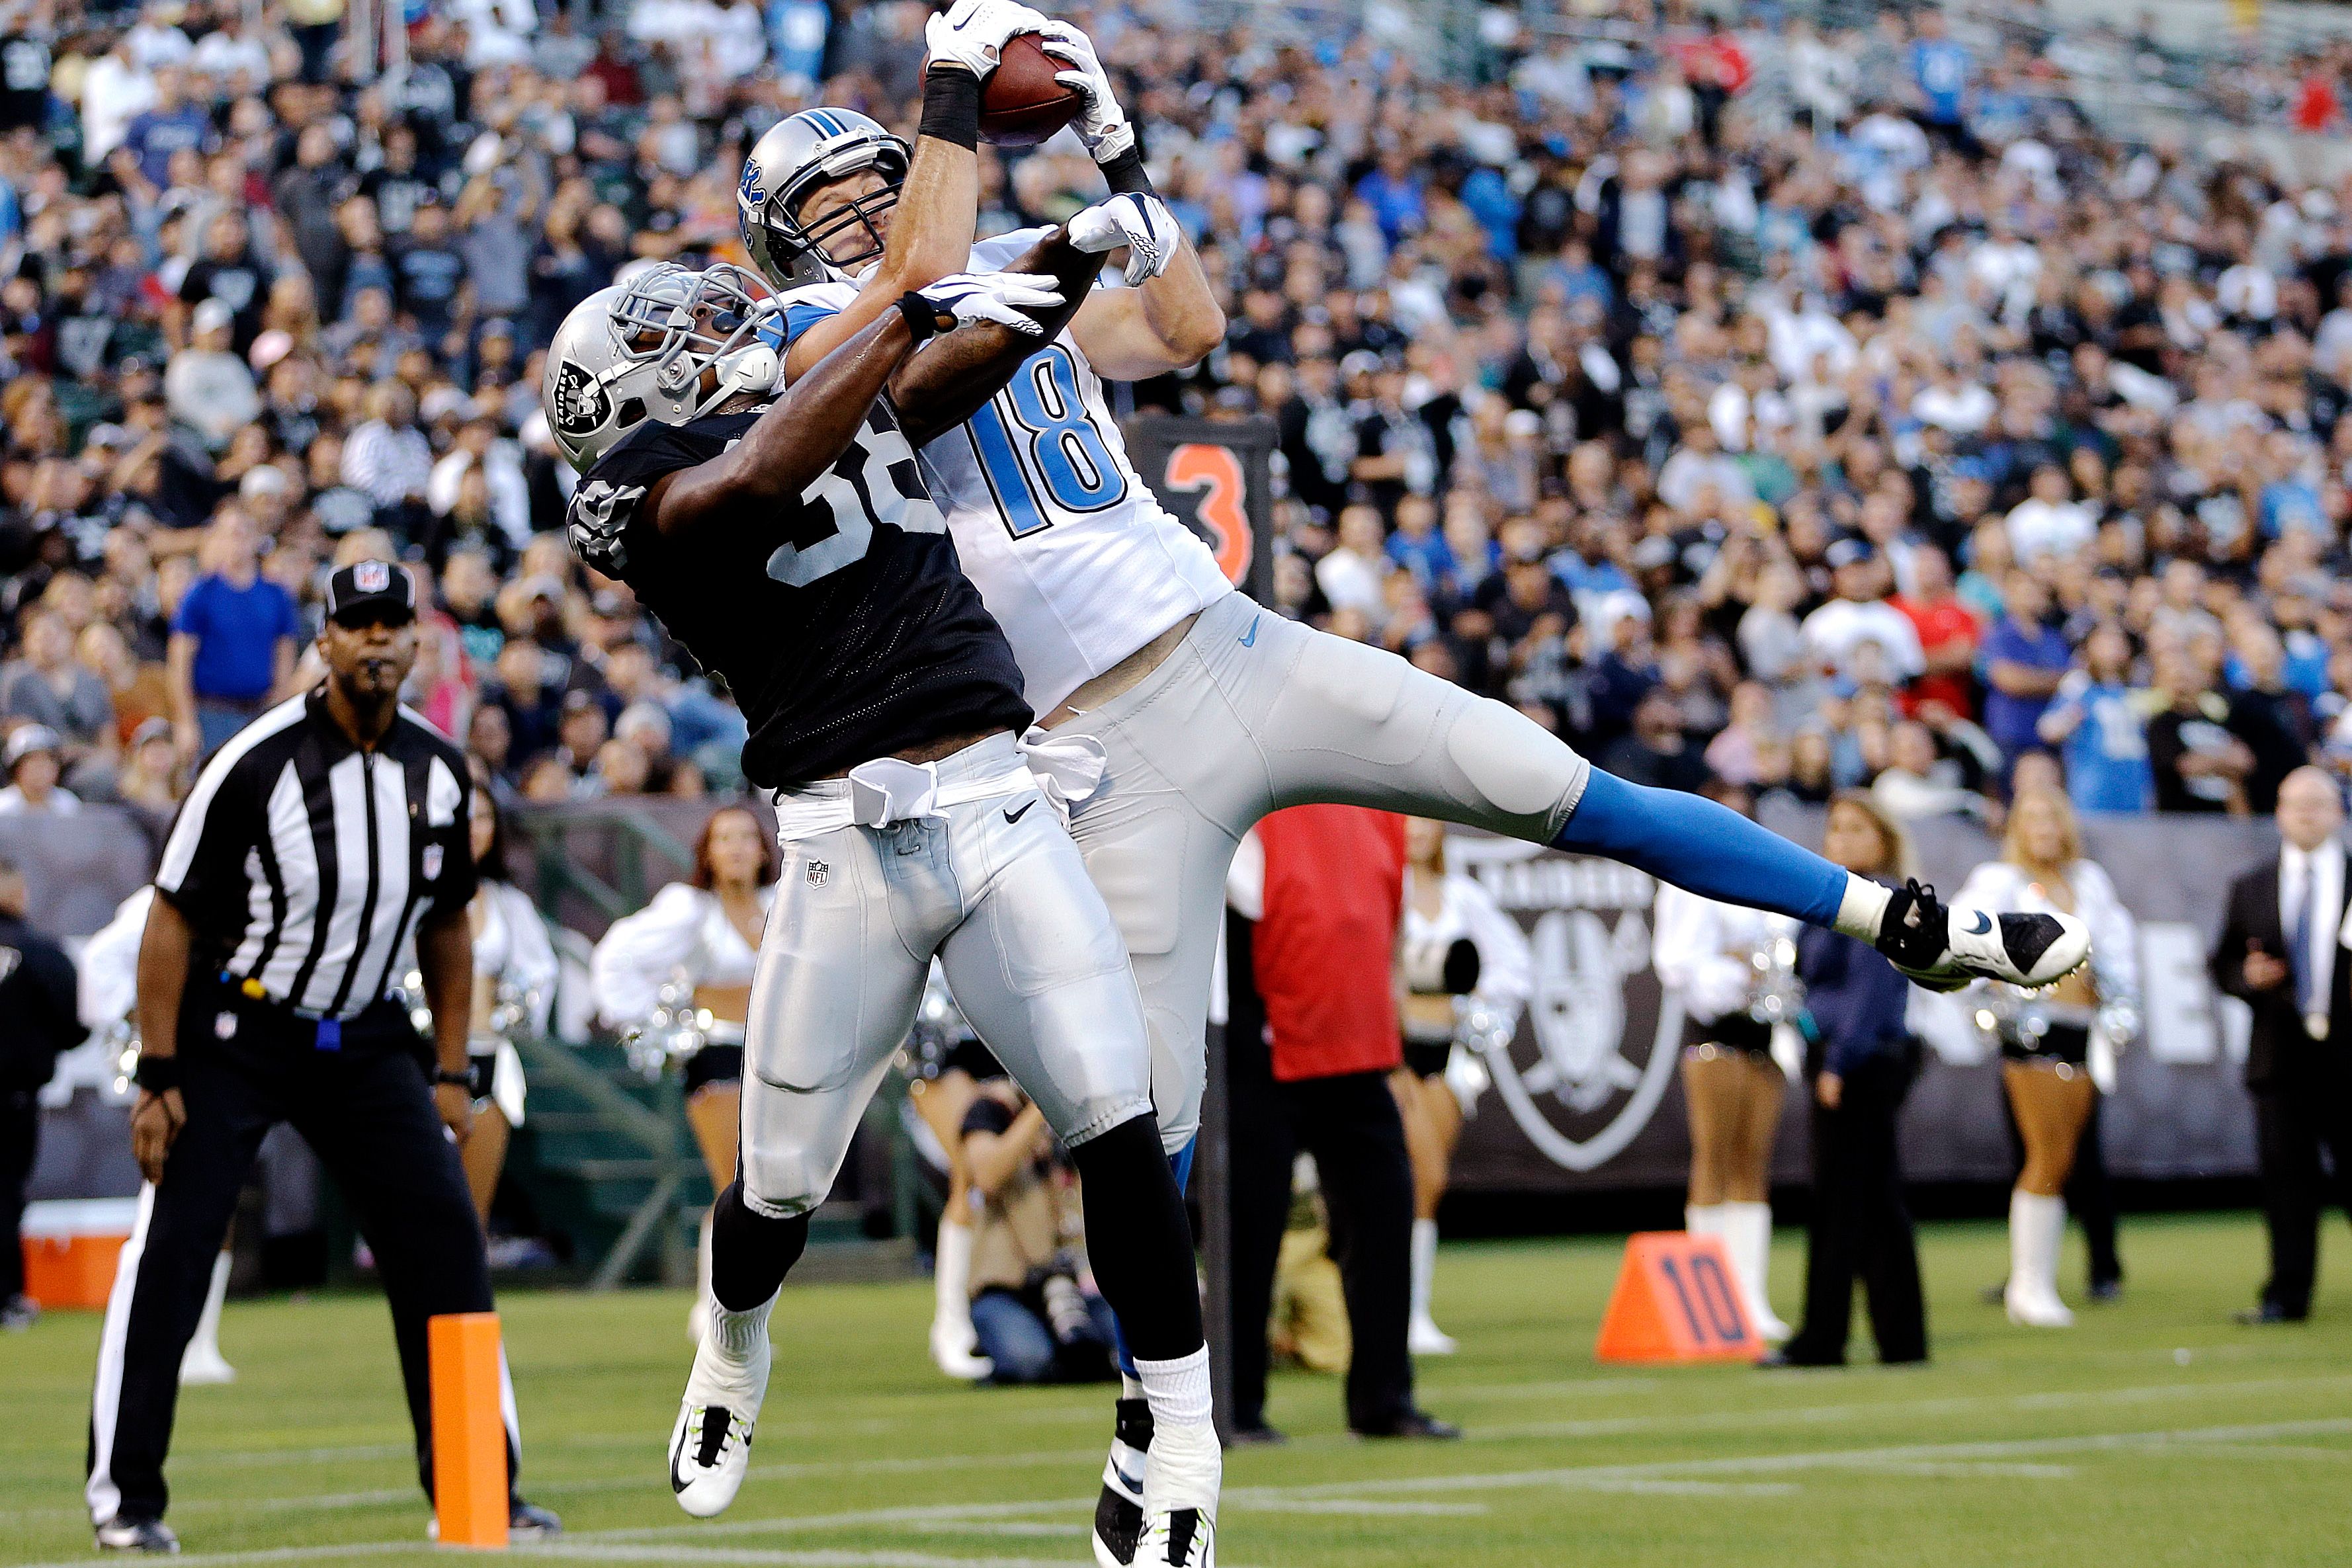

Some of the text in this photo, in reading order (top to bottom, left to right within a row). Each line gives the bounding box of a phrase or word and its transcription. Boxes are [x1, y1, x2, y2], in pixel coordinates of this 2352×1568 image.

[558, 368, 567, 424] RAIDERS
[962, 341, 1128, 541] 18
[1164, 442, 1254, 591] 3
[809, 872, 825, 884] NFL
[1663, 1255, 1747, 1342] 10
